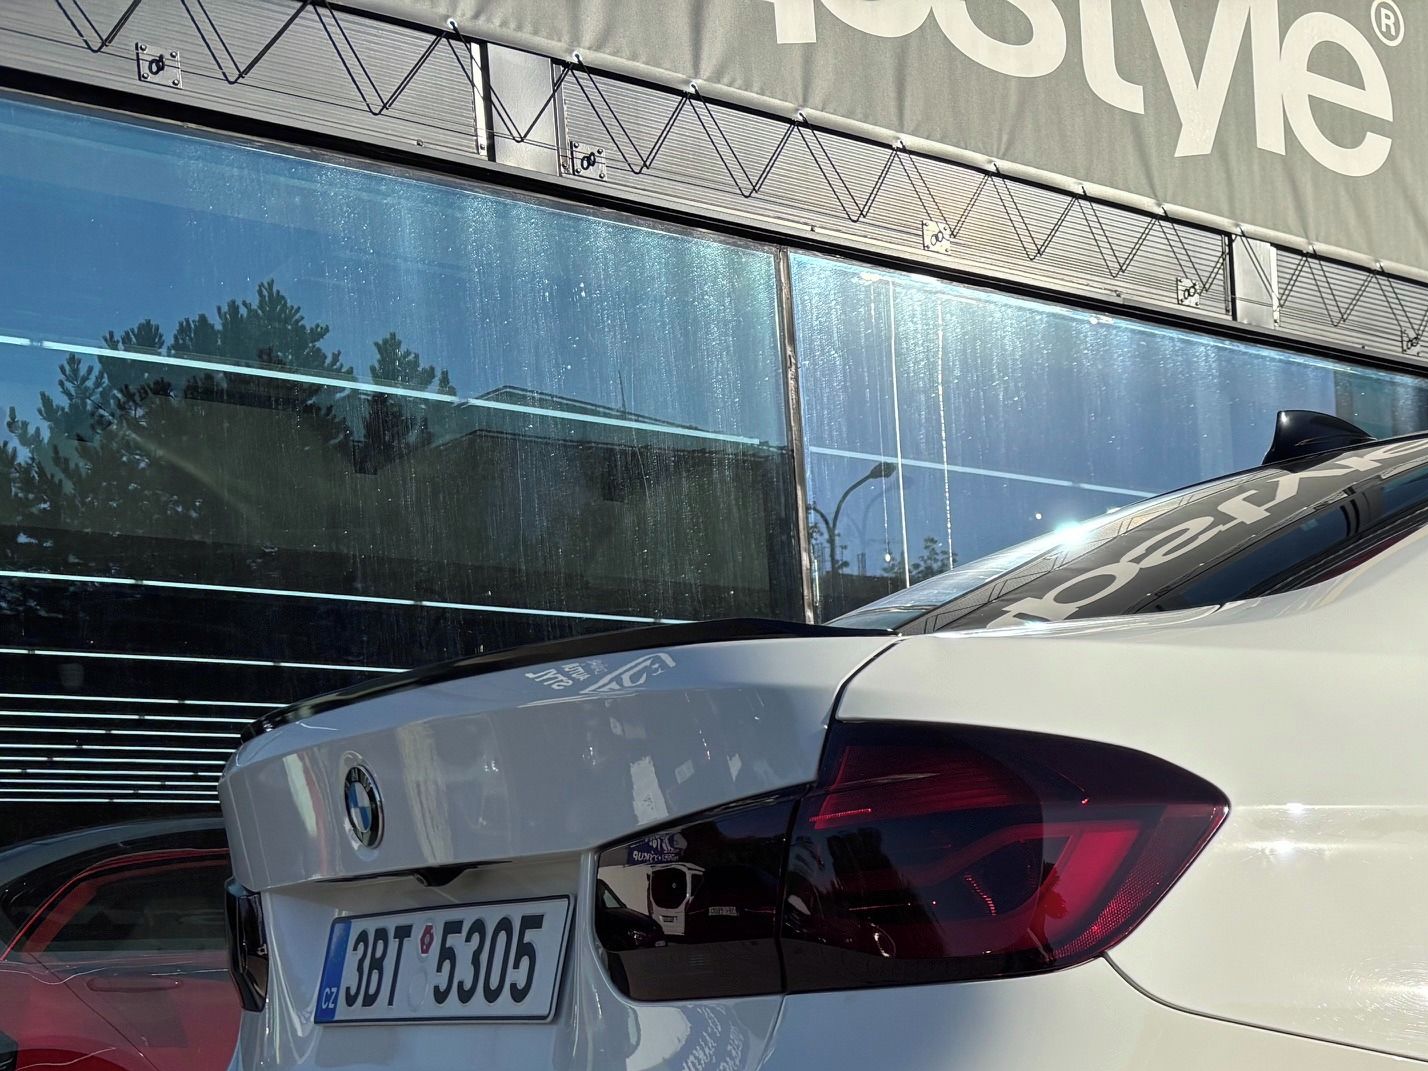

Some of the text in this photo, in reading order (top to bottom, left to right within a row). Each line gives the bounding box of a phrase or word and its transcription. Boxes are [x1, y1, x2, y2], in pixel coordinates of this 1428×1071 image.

[344, 914, 546, 1009] 3BT 5305
[321, 986, 338, 1010] CZ
